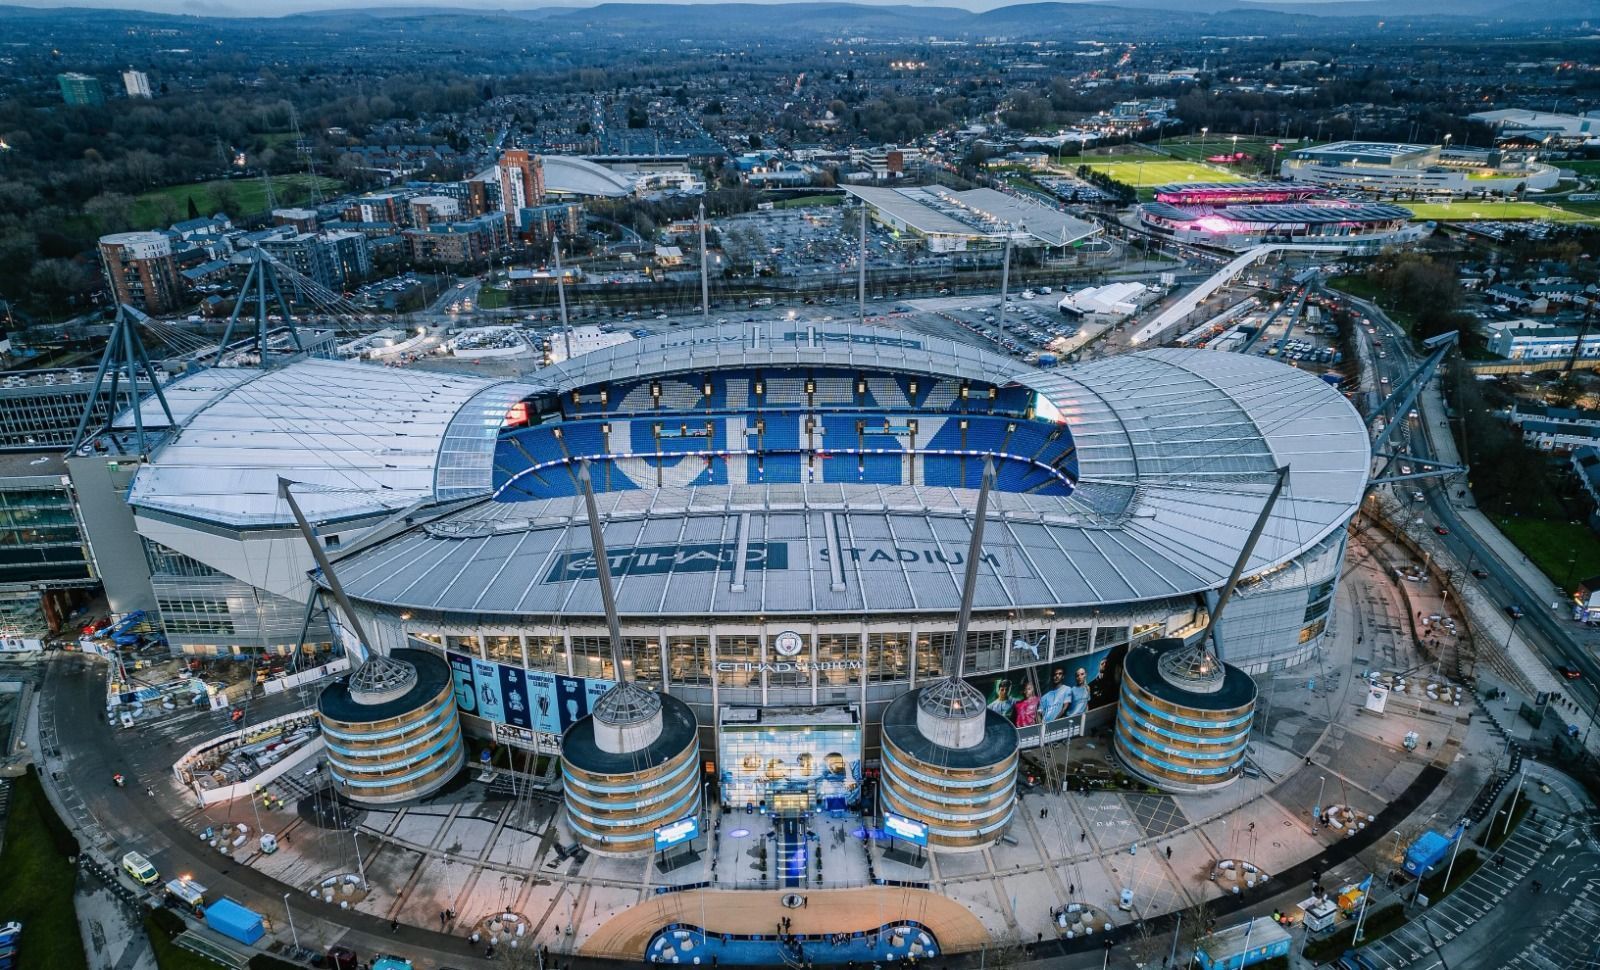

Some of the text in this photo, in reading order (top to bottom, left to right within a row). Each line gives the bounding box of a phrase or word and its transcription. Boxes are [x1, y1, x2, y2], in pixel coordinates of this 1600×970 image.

[566, 549, 766, 572] ETIHAD
[717, 661, 861, 673] ETIHAD STADIUM
[453, 669, 475, 711] 5
